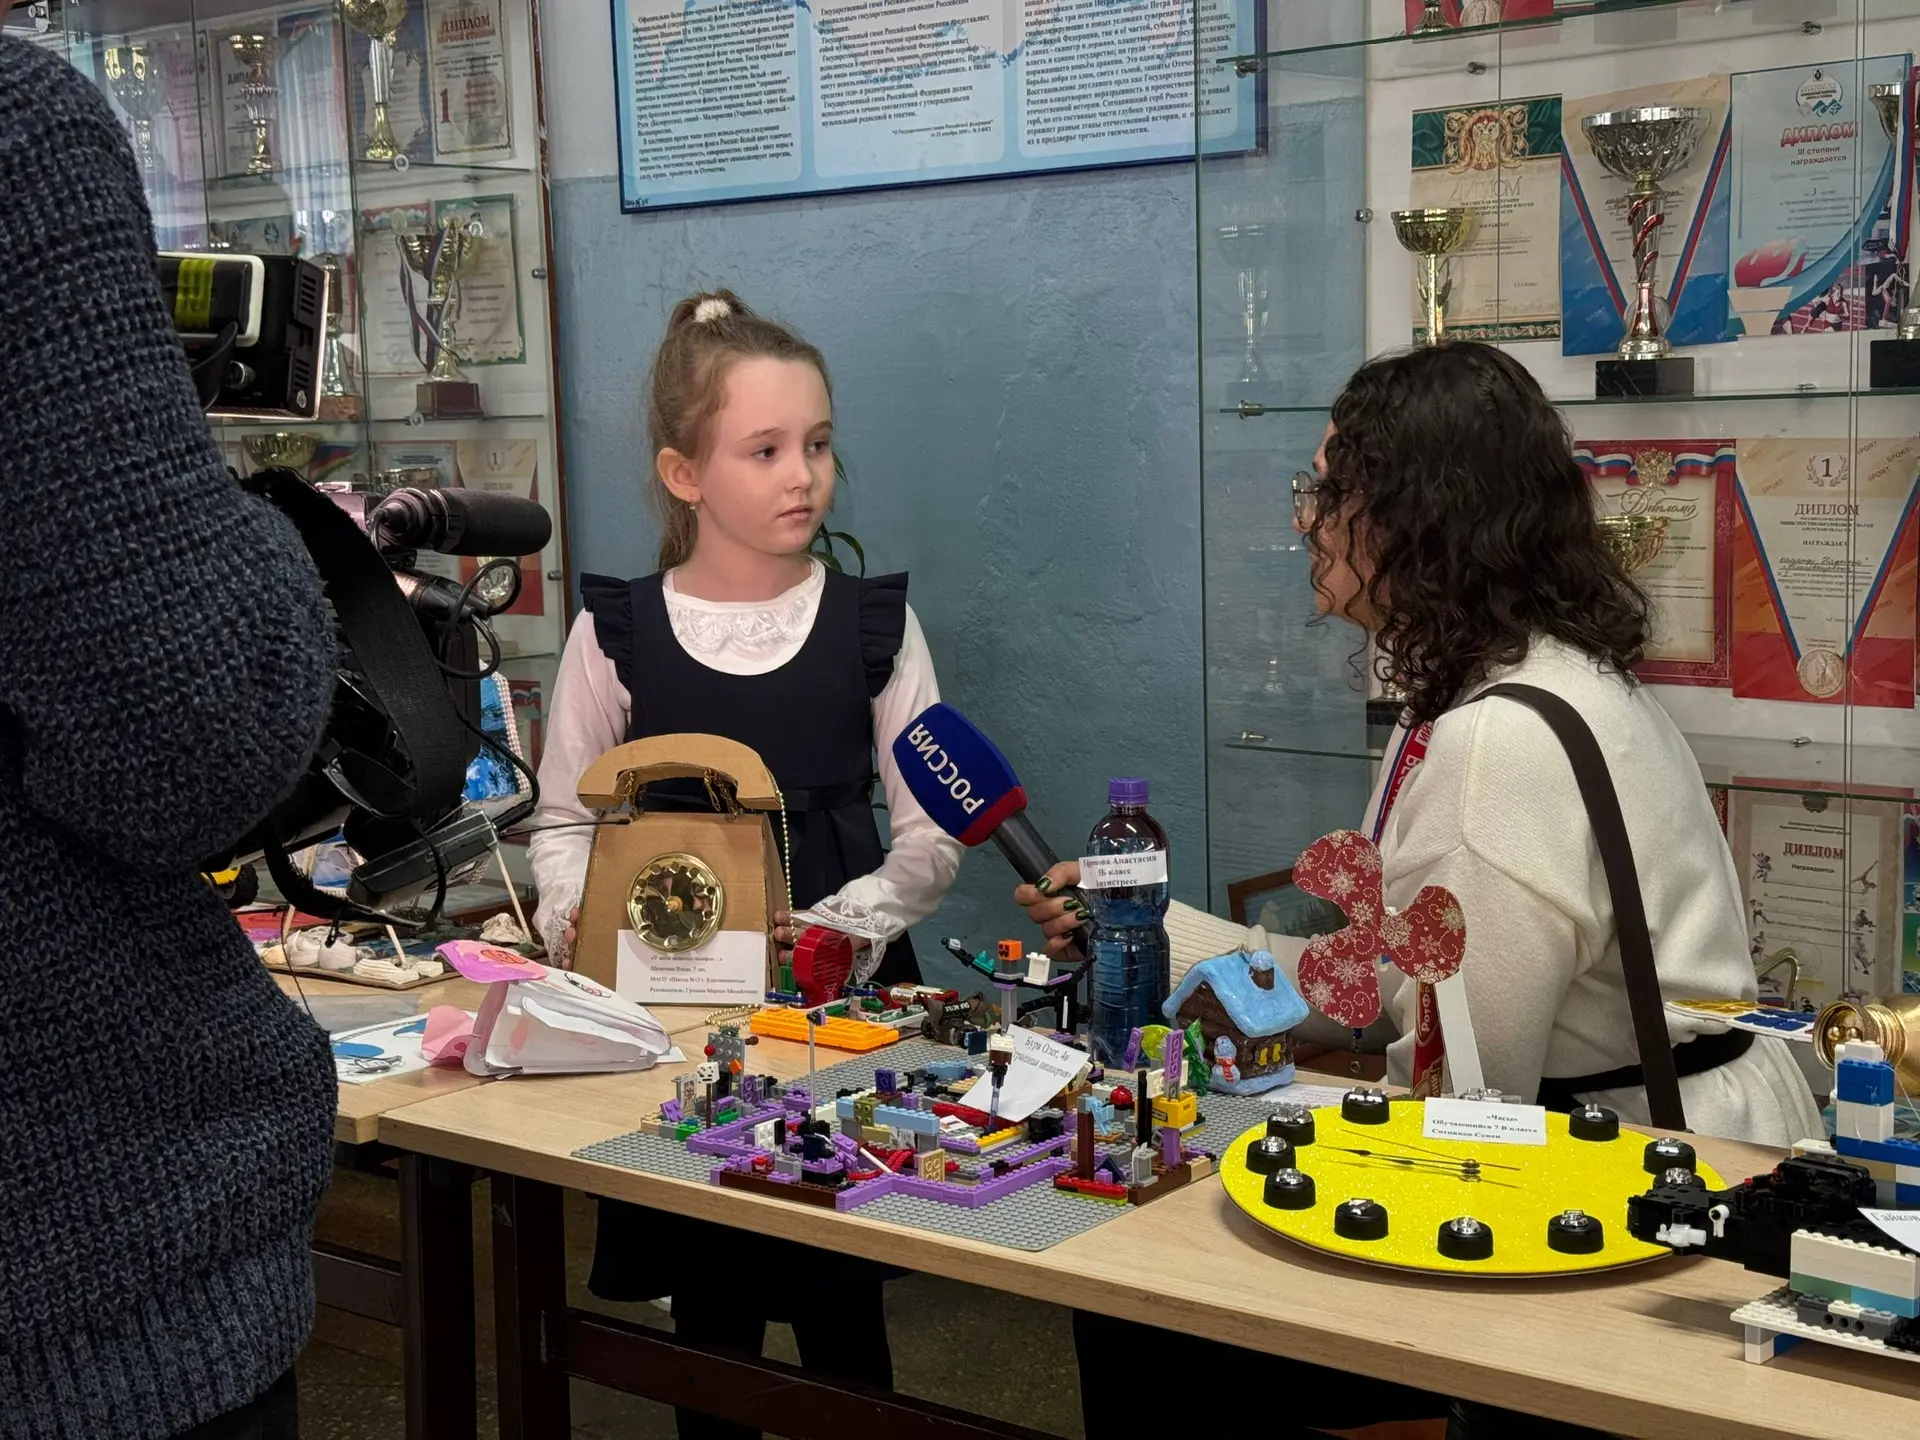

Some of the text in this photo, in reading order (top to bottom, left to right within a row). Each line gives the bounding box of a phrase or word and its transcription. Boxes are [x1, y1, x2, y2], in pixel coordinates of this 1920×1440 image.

[440, 88, 451, 124] 1
[1781, 120, 1858, 148] ДИПЛОМ
[1807, 147, 1840, 155] степени
[1790, 155, 1847, 167] награждается
[1821, 458, 1833, 478] 1
[1867, 466, 1890, 482] SPORT
[1795, 504, 1860, 516] ДИПЛОМ
[907, 723, 985, 815] РОССИЯ
[1783, 842, 1845, 860] ДИПЛОМ
[1113, 855, 1156, 865] Анастасия
[1432, 1119, 1492, 1130] Обучающийся
[1486, 1114, 1518, 1122] «Часы»
